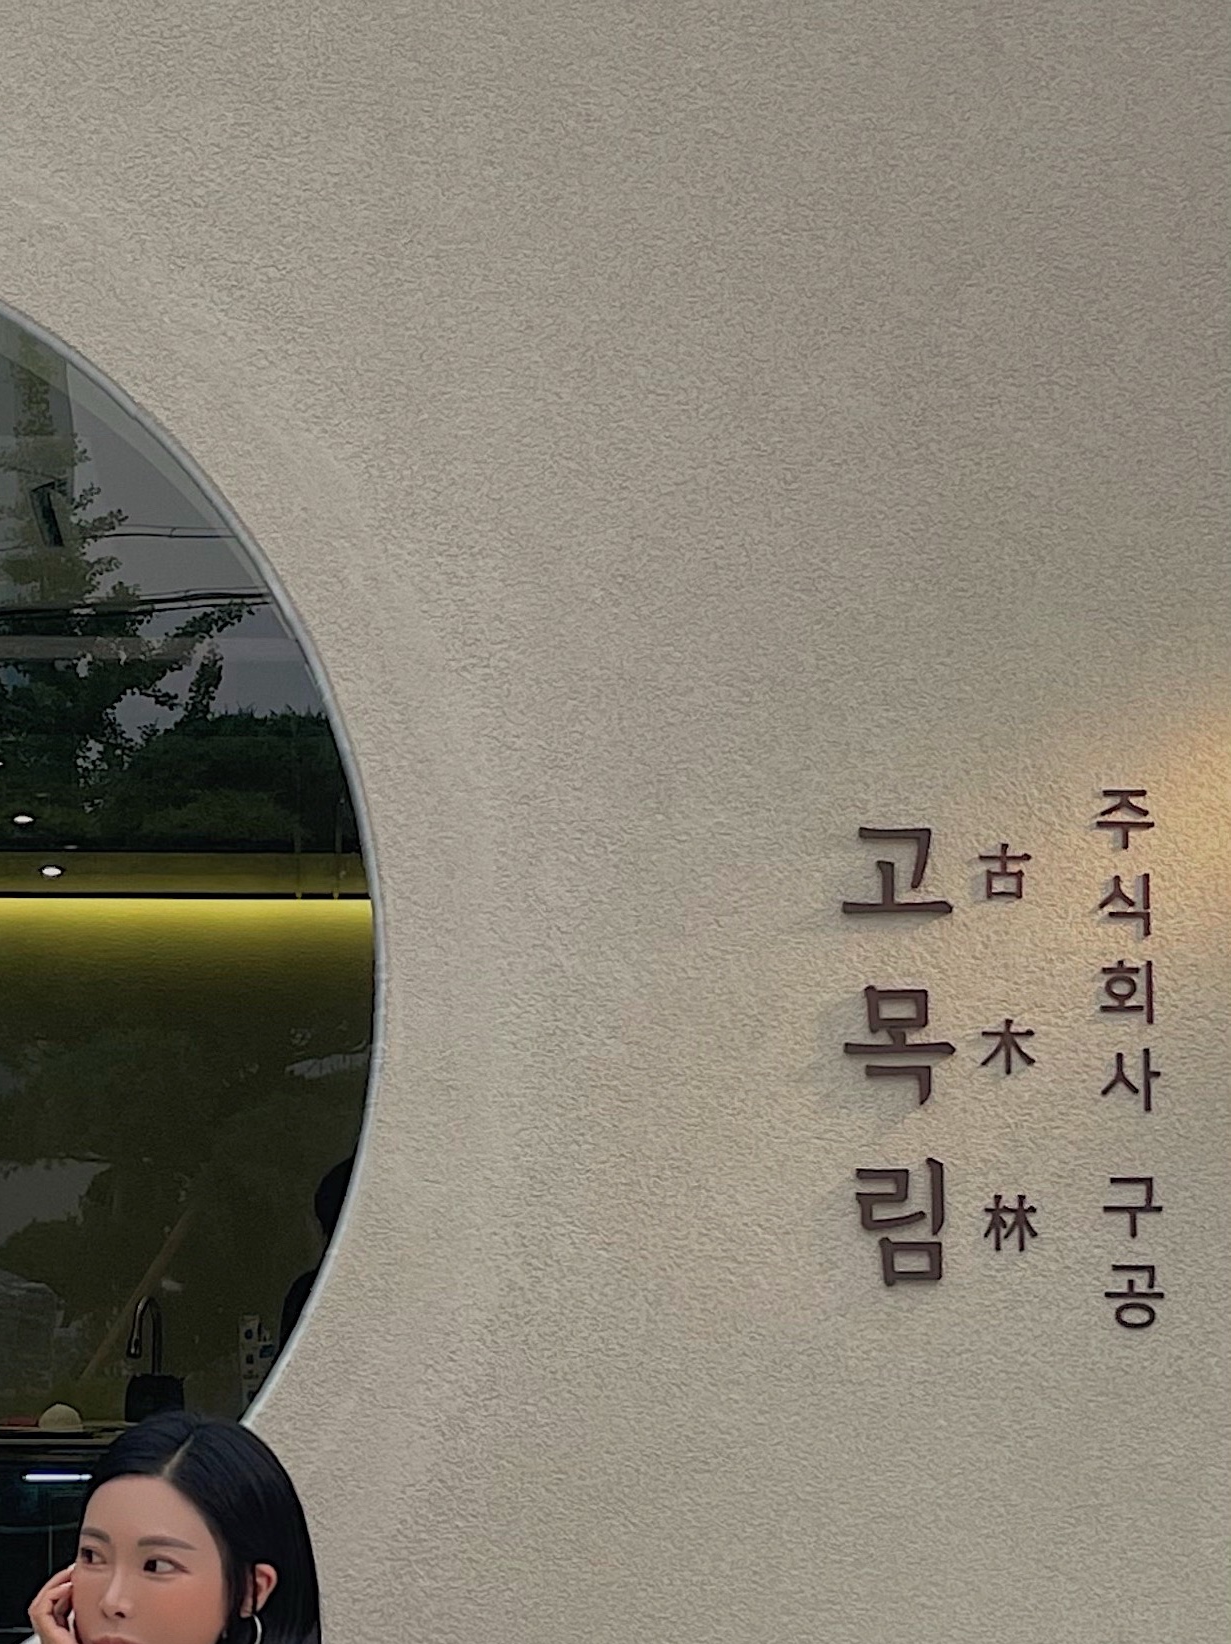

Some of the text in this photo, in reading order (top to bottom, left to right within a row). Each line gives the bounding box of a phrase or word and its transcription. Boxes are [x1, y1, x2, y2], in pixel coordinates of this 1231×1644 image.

[841, 826, 957, 1288] 고목림
[978, 842, 1039, 1253] 古木林
[1095, 788, 1165, 1330] 주식회사 구공
